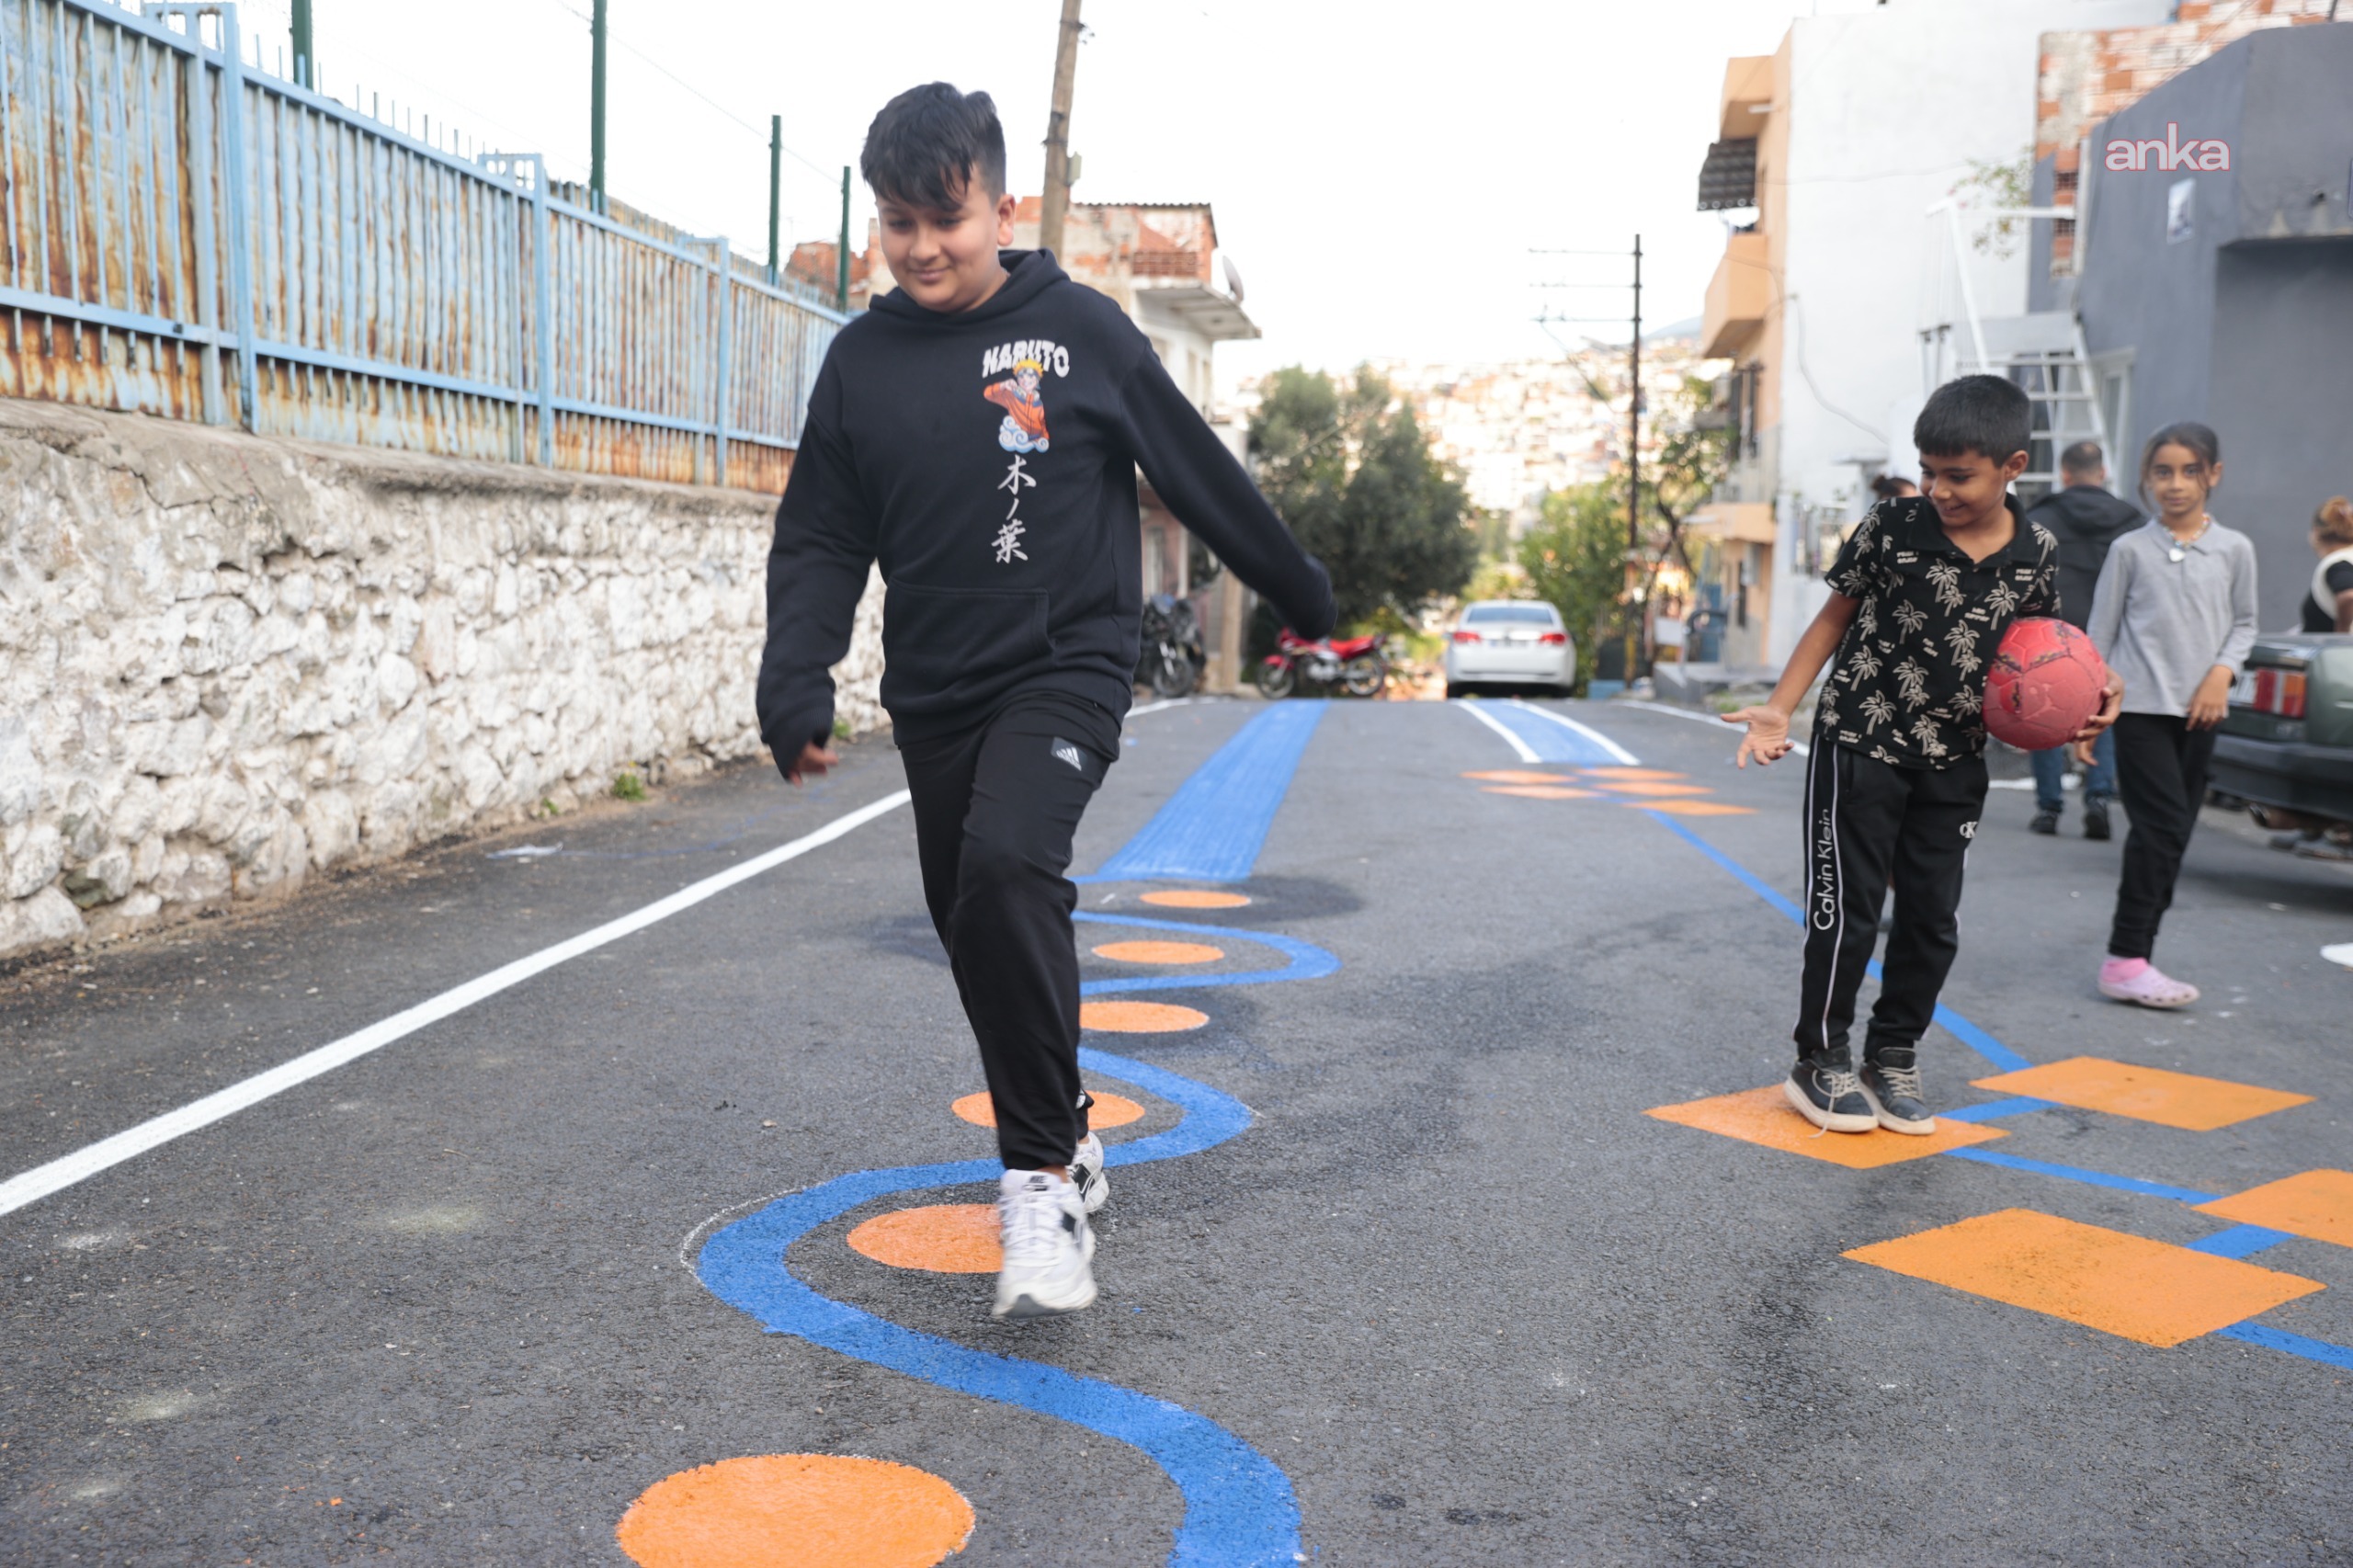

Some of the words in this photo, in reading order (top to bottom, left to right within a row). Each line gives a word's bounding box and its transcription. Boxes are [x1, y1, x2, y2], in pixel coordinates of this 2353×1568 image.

[982, 339, 1070, 379] NARUTO
[1817, 809, 1833, 859] Klein
[1813, 864, 1836, 930] Calvin
